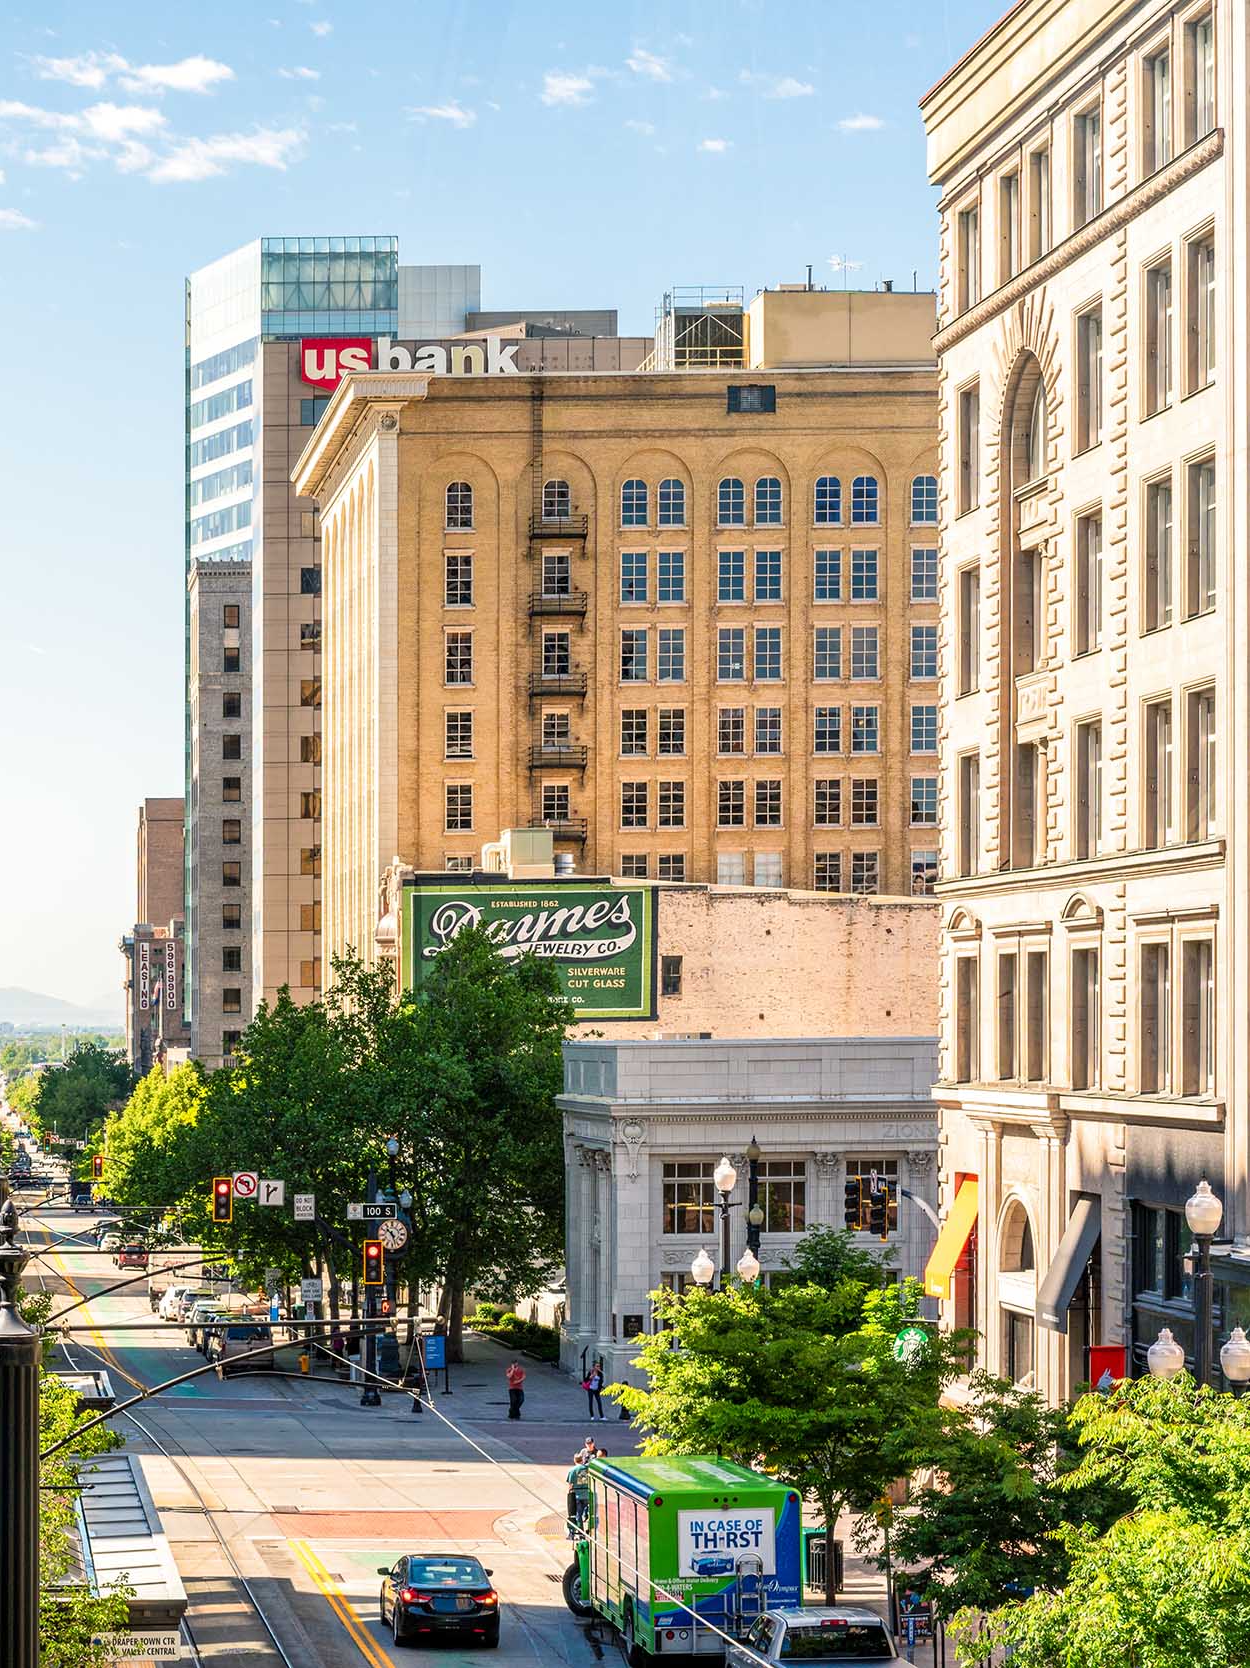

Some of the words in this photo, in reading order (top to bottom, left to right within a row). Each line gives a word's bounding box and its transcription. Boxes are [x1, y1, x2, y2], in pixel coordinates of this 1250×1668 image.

[540, 900, 559, 908] 1862
[528, 943, 595, 956] JEWELRY
[597, 941, 622, 954] CO.
[167, 943, 175, 1009] 596-9900
[567, 968, 626, 976] SILVERWARE
[567, 980, 590, 988] CUT
[593, 979, 626, 988] GLASS
[882, 1123, 935, 1138] ZIONS
[366, 1207, 381, 1216] 100
[689, 1521, 704, 1532] IN
[707, 1520, 742, 1532] CASE
[744, 1519, 763, 1531] OF
[112, 1638, 138, 1646] DRAPER
[140, 1637, 161, 1646] TOWN
[162, 1637, 176, 1645] CTR
[147, 1647, 176, 1656] CENTRAL
